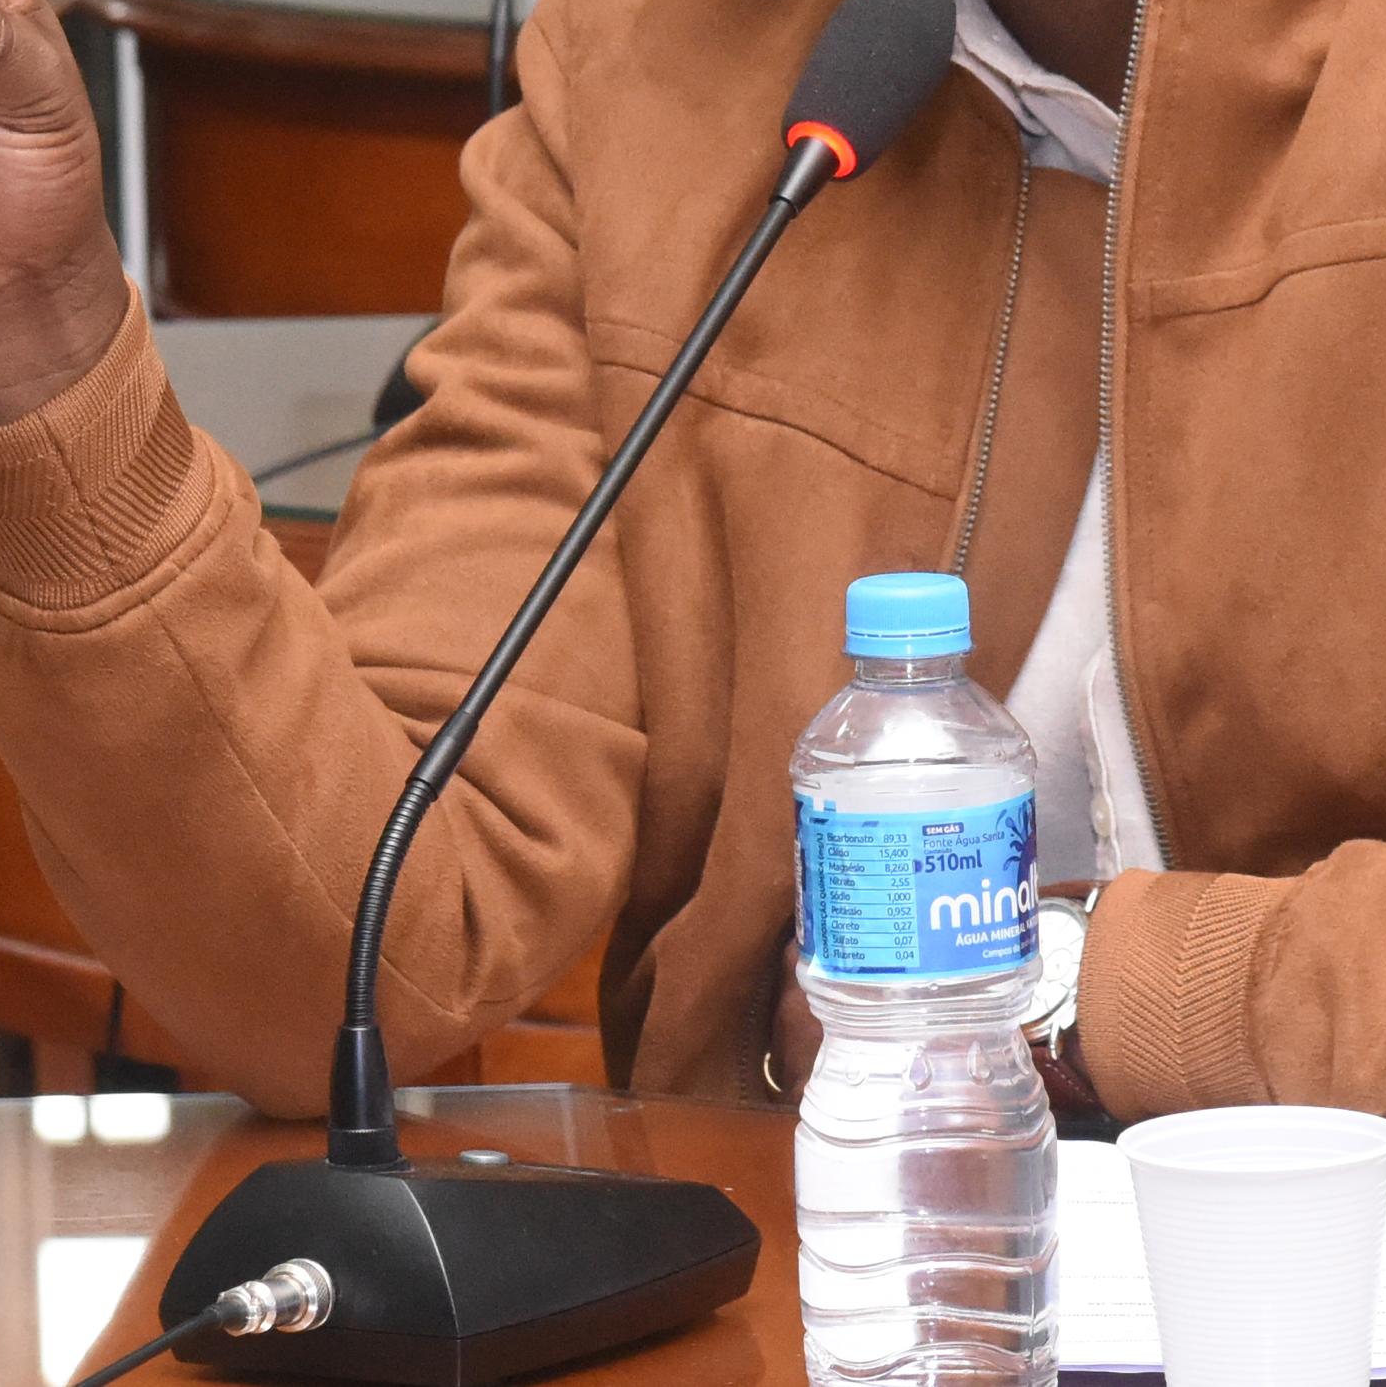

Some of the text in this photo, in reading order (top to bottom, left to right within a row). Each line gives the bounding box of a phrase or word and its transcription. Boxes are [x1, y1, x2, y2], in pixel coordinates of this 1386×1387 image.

[926, 825, 960, 835] SEM GÁS
[923, 838, 953, 848] Fonte
[955, 834, 981, 847] Água
[880, 849, 909, 859] 15,400
[925, 849, 983, 873] 510ml
[891, 878, 910, 887] 2,55
[887, 893, 911, 902] 1,000
[832, 920, 912, 931] Cloreto 0,27
[894, 936, 913, 946] 0,07
[955, 931, 989, 947] ÁGUA
[895, 951, 914, 960] 0,04
